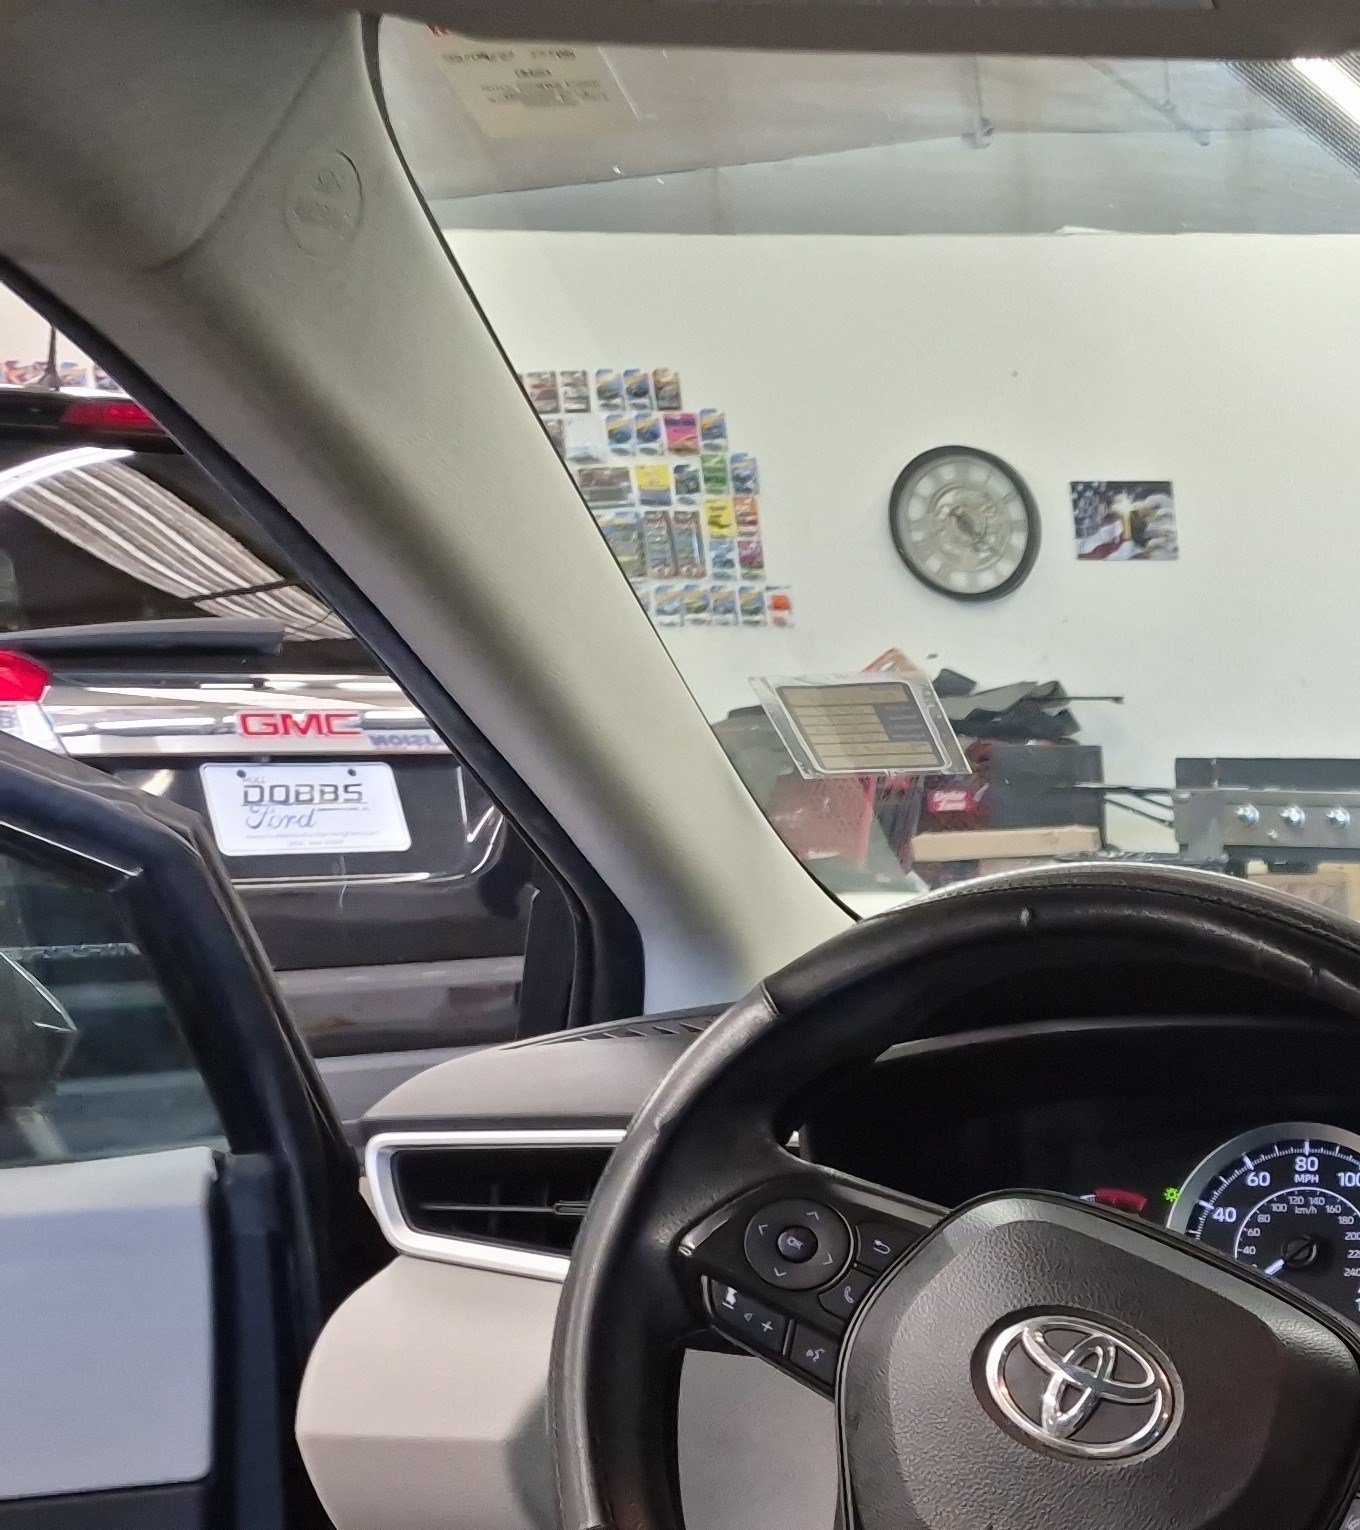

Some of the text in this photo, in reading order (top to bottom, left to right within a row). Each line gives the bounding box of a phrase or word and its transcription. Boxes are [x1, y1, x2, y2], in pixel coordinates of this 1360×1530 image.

[239, 713, 362, 736] GMC
[243, 783, 363, 804] DOBBS
[245, 805, 316, 829] Ford
[1294, 1156, 1319, 1171] 80
[1246, 1171, 1271, 1187] 60
[1294, 1174, 1319, 1183] MPH
[1288, 1196, 1304, 1205] 120
[1309, 1197, 1325, 1205] 140
[1295, 1206, 1317, 1214] km/h
[1325, 1205, 1341, 1213] 160
[1212, 1206, 1237, 1222] 40
[1338, 1216, 1354, 1225] 180
[1247, 1228, 1260, 1237] 60
[1242, 1246, 1256, 1255] 40
